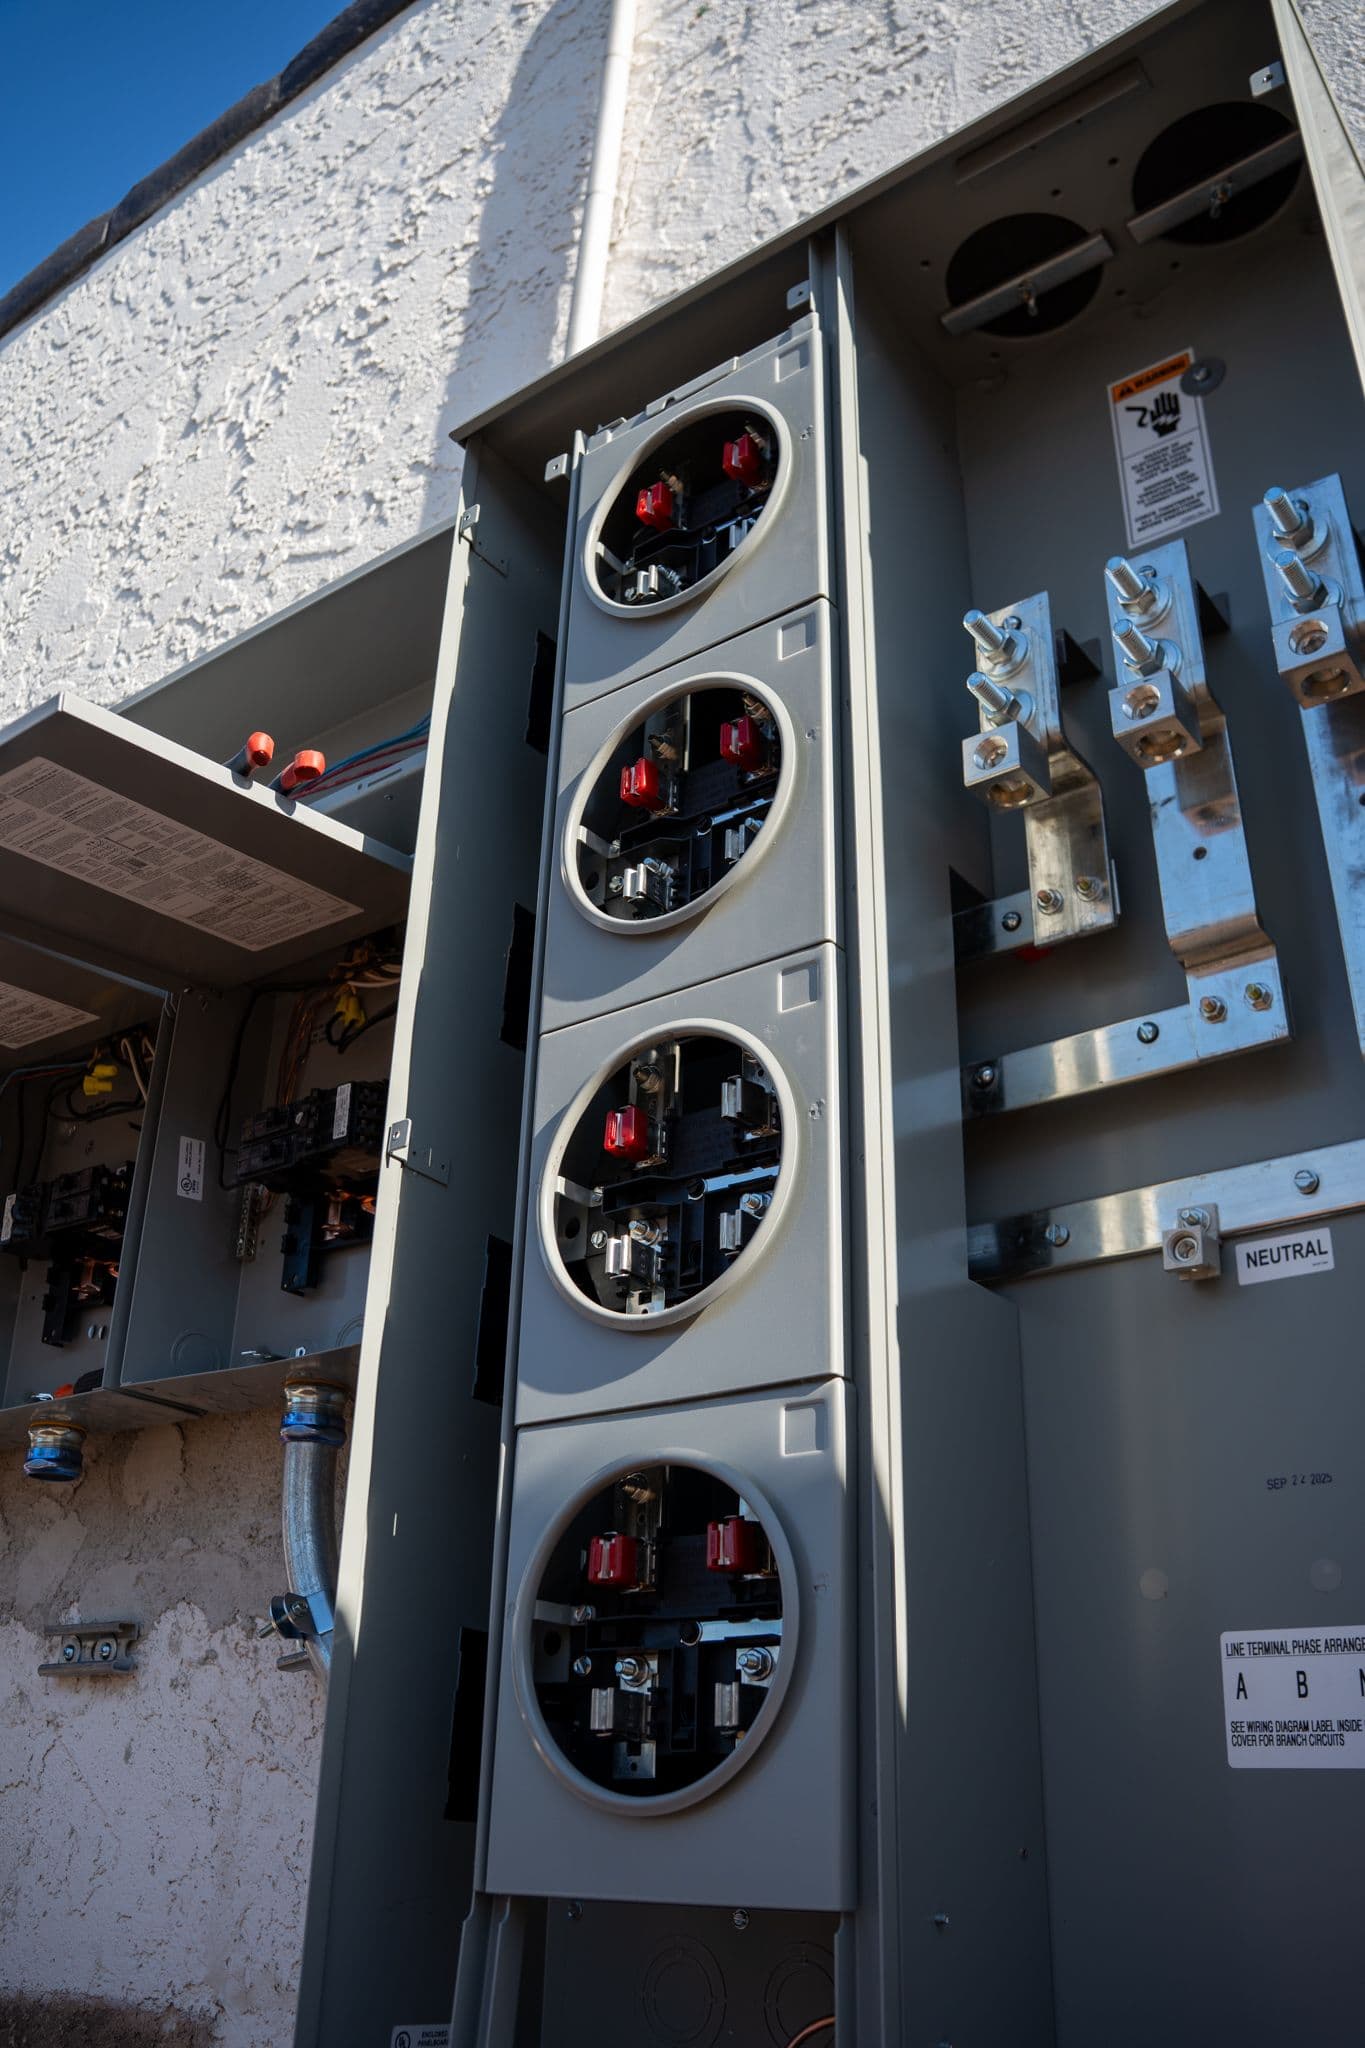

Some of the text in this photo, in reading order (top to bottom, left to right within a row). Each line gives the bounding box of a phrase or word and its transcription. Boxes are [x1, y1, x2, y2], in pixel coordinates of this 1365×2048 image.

[1246, 1239, 1329, 1269] NEUTRAL
[1266, 1477, 1287, 1490] SEP
[1225, 1642, 1245, 1657] LINE
[1247, 1640, 1290, 1656] TERMINAL
[1292, 1639, 1321, 1654] PHASE
[1236, 1672, 1248, 1700] A
[1296, 1670, 1309, 1698] B
[1231, 1721, 1245, 1733] SEE
[1247, 1720, 1273, 1733] WIRING
[1275, 1720, 1309, 1732] DIAGRAM
[1311, 1720, 1336, 1732] LABEL
[1337, 1719, 1362, 1732] INSIDE
[1231, 1733, 1344, 1747] COVER FOR BRANCH CIRCUITS
